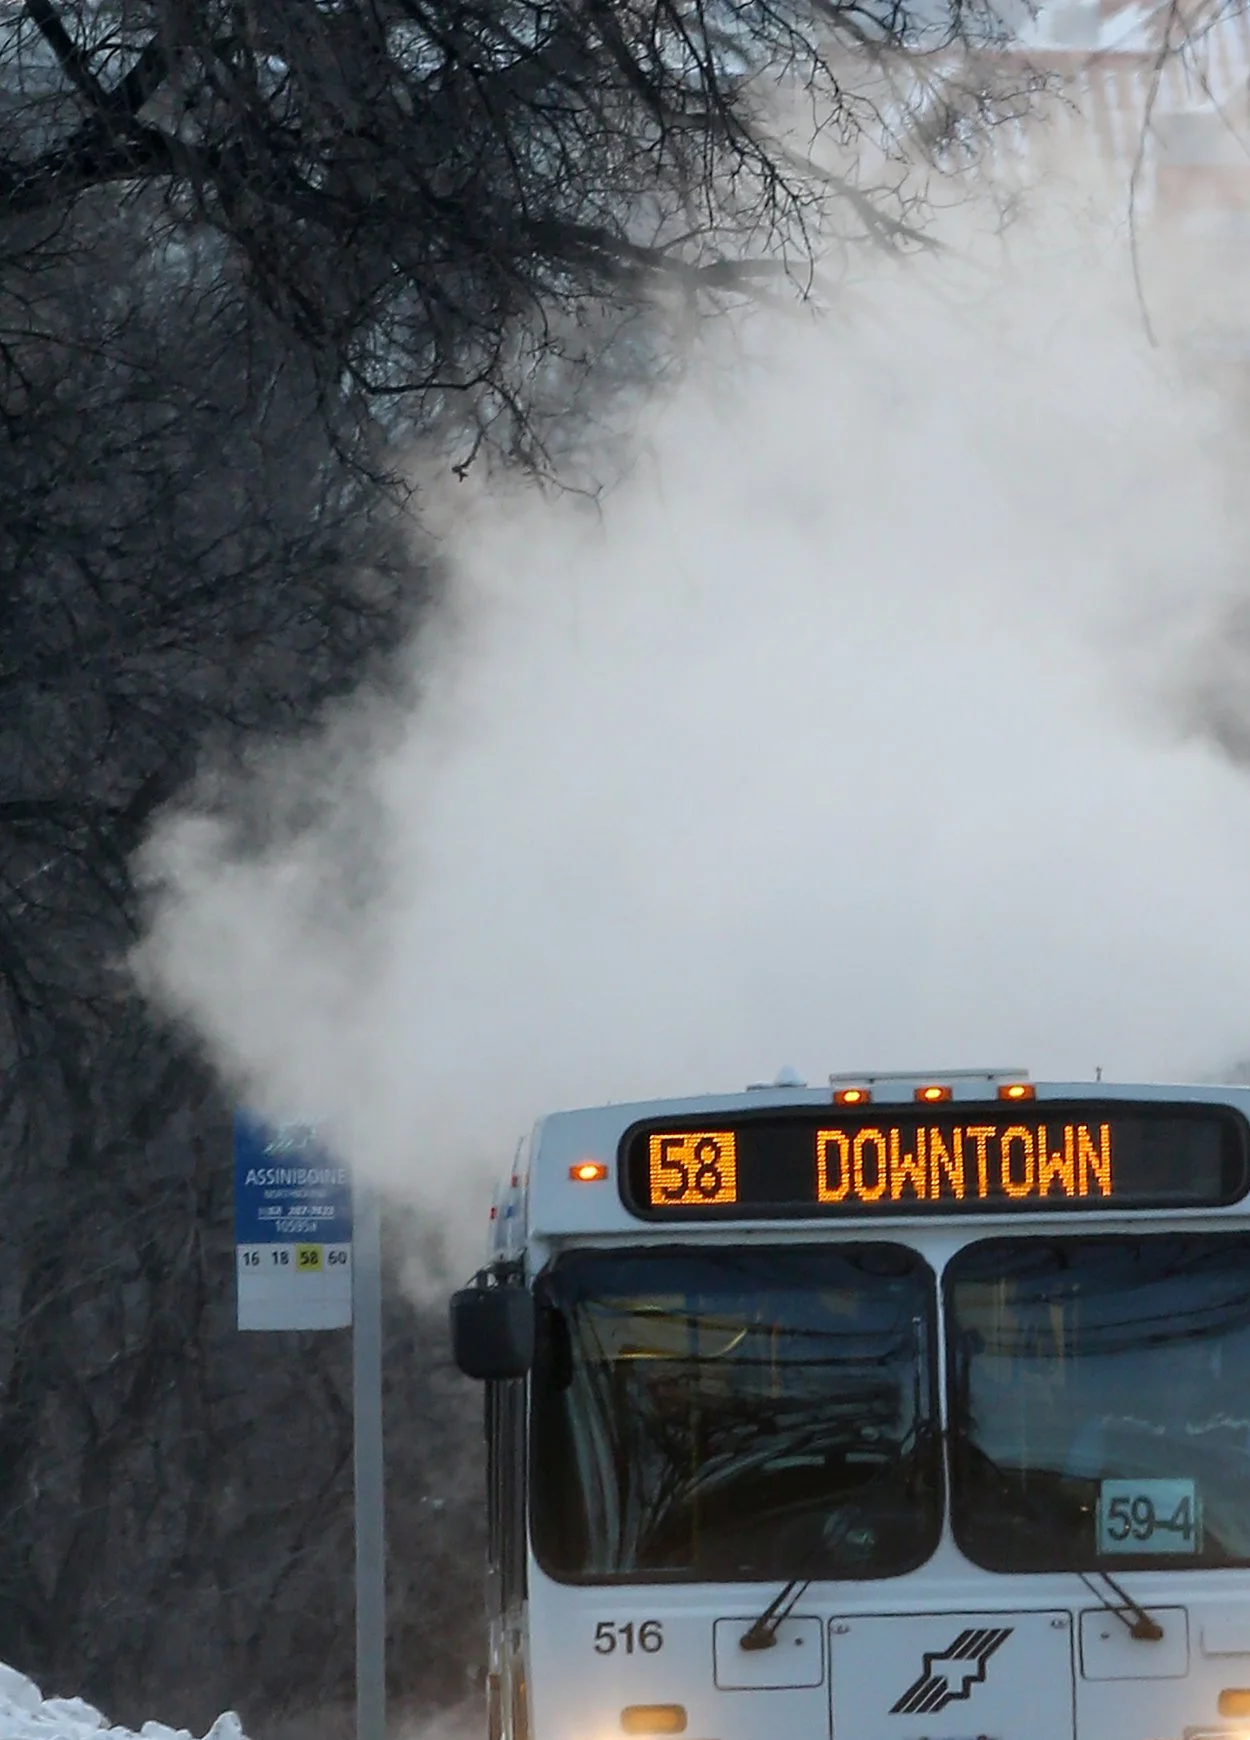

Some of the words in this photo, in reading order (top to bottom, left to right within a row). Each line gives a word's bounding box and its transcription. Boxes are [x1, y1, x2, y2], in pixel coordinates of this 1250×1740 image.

[244, 1167, 348, 1186] ASSINIBOINE
[659, 1136, 723, 1200] 58
[815, 1124, 1112, 1202] DOWNTOWN
[243, 1250, 260, 1267] 16
[271, 1250, 289, 1266] 18
[300, 1250, 320, 1267] 58
[327, 1250, 348, 1266] 60
[1107, 1494, 1192, 1541] 59-4
[593, 1619, 664, 1655] 516
